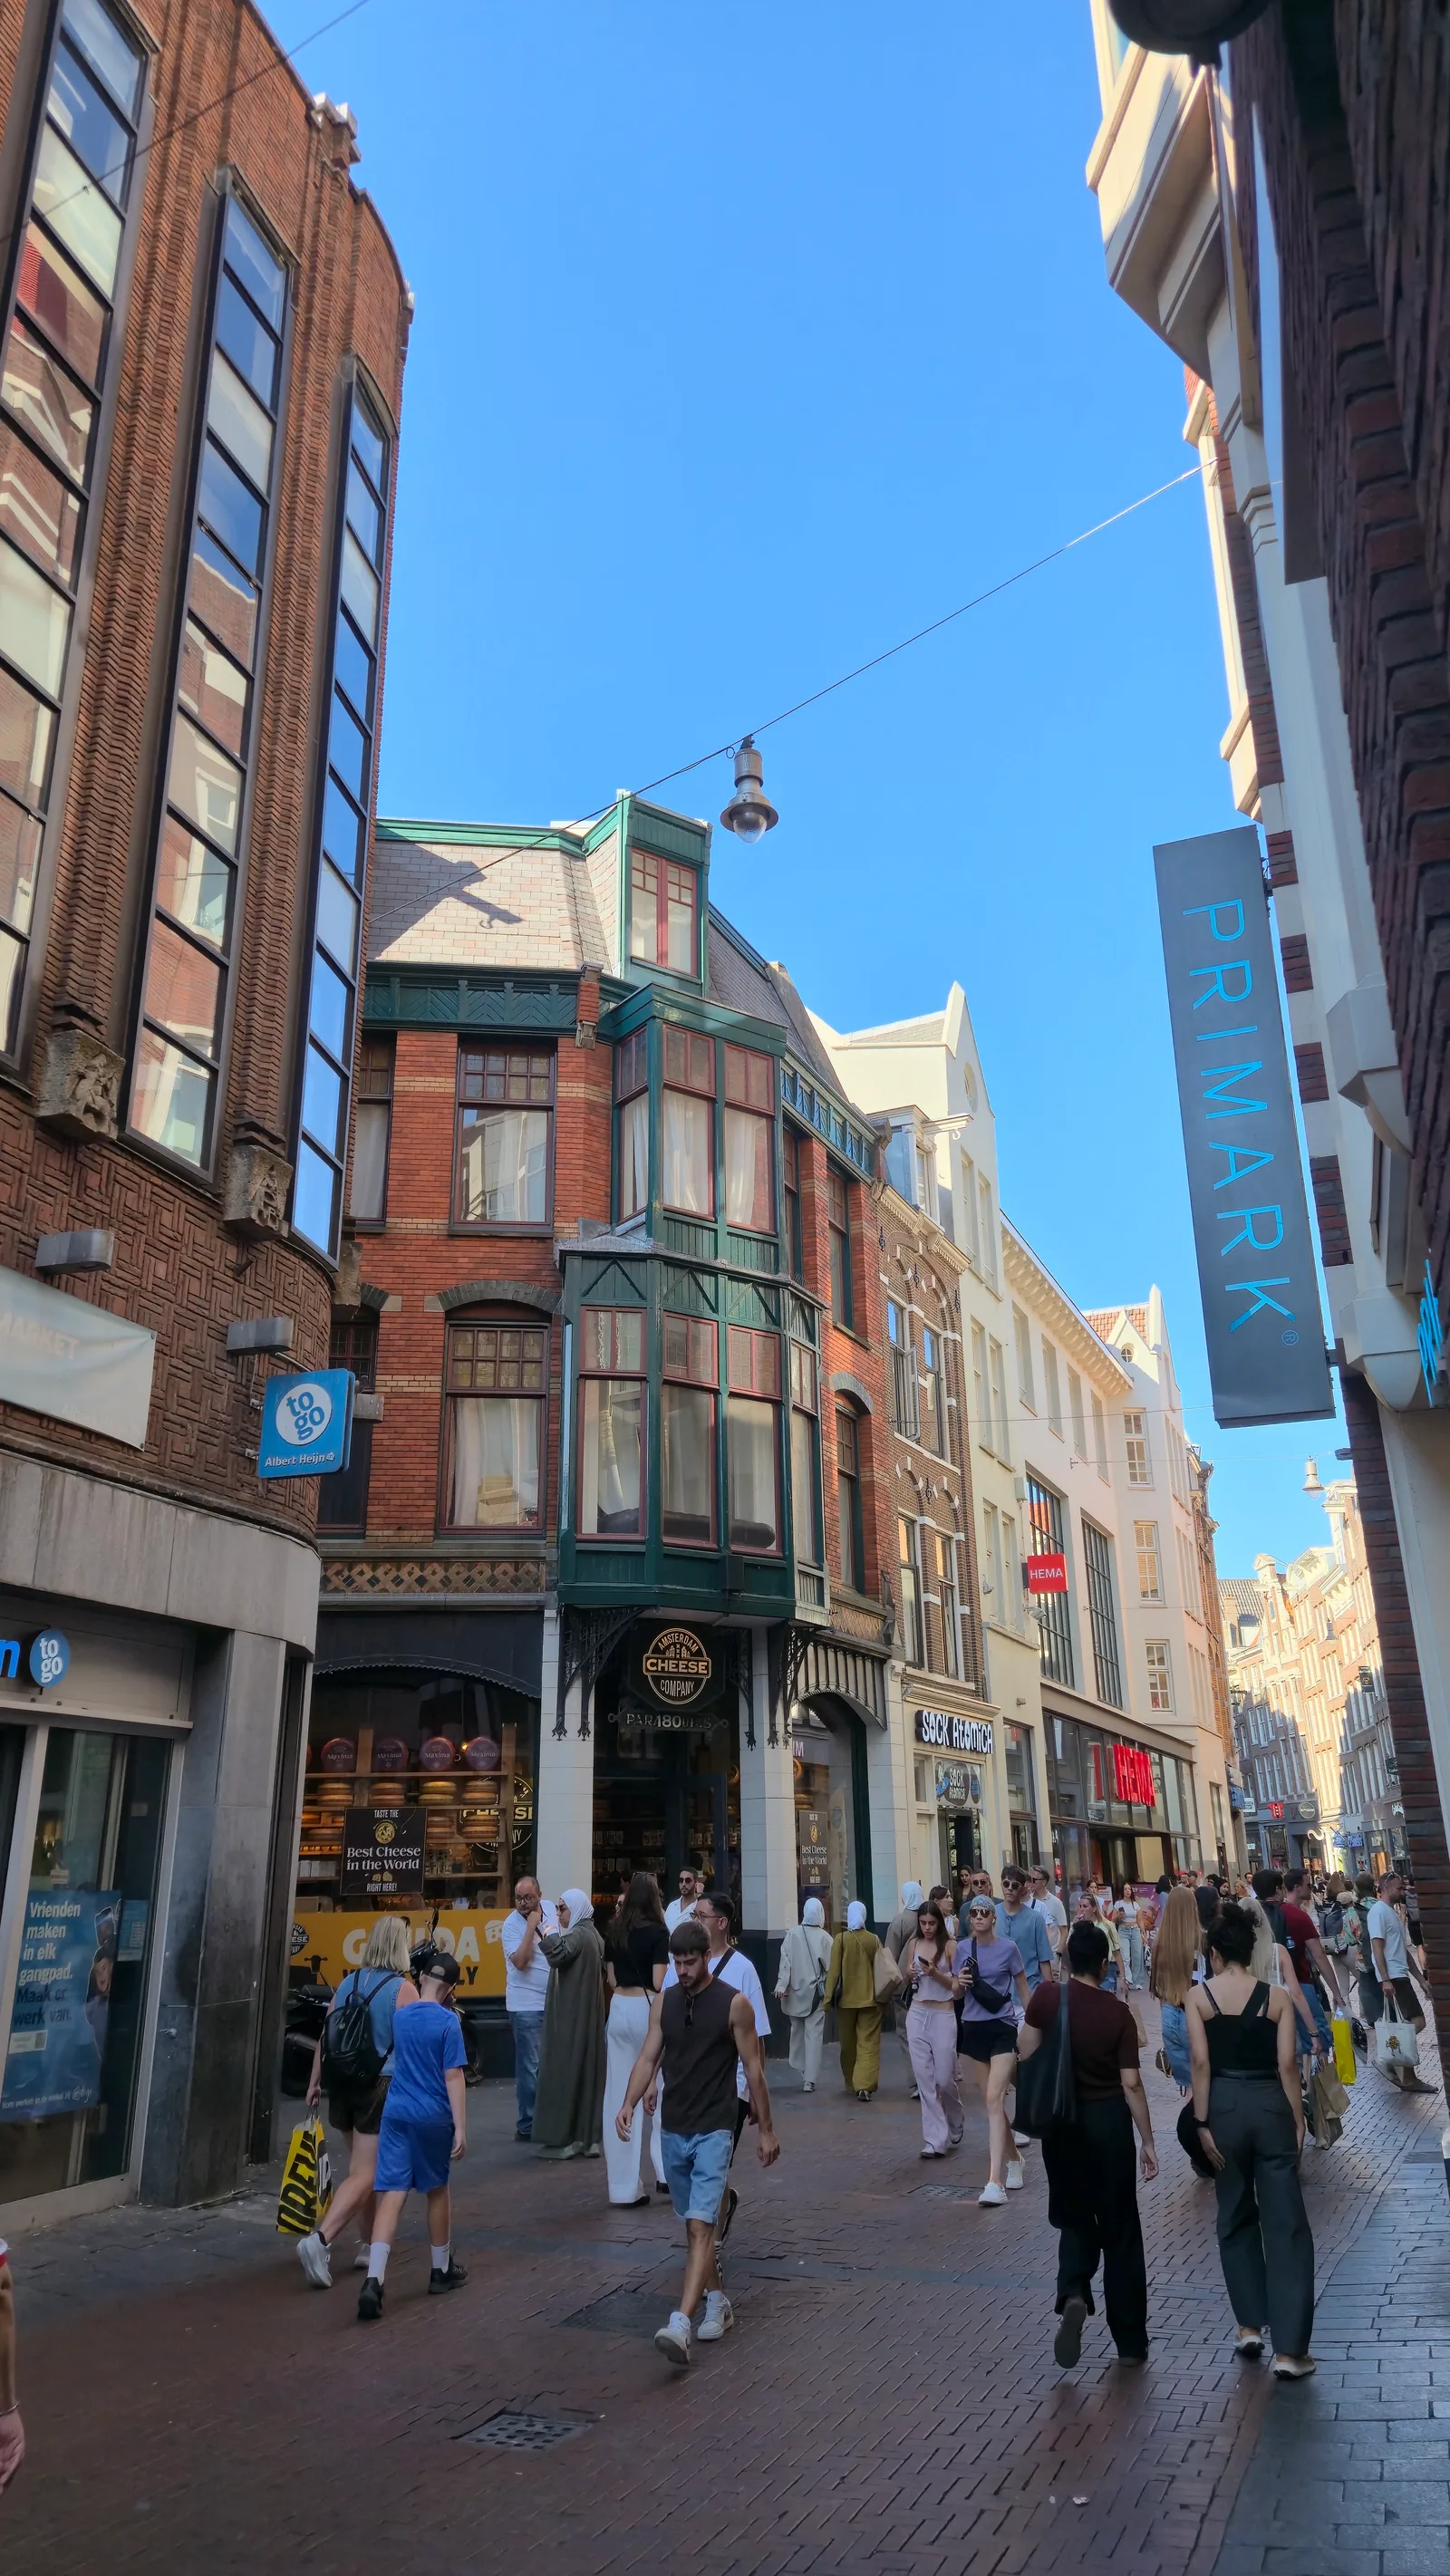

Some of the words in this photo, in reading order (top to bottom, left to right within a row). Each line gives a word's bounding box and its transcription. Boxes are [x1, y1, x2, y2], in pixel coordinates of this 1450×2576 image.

[1183, 899, 1297, 1332] PRIMARK
[286, 1392, 314, 1417] to
[295, 1406, 325, 1441] go
[265, 1455, 296, 1467] Albert
[299, 1452, 324, 1464] Heijn
[1030, 1568, 1064, 1579] HEMA
[40, 1637, 58, 1659] to
[658, 1633, 699, 1653] AMSTERDAM
[41, 1657, 63, 1684] go
[646, 1659, 707, 1674] CHEESE
[660, 1680, 695, 1697] COMPANY
[922, 1710, 950, 1746] SOCK
[1112, 1743, 1156, 1807] HEMA
[373, 1809, 388, 1818] TASTE
[390, 1809, 399, 1818] THE
[346, 1847, 373, 1857] Best
[376, 1847, 420, 1857] Cheese
[346, 1859, 359, 1870] in
[362, 1859, 382, 1870] the
[383, 1859, 420, 1869] World
[366, 1883, 382, 1892] RIGHT
[382, 1883, 397, 1891] HERE!
[30, 1900, 81, 1918] Vrienden
[26, 1922, 66, 1939] maken
[23, 1944, 34, 1961] in
[37, 1943, 57, 1960] elk
[18, 1962, 72, 1987] gangpad.
[15, 1984, 52, 2003] Maak
